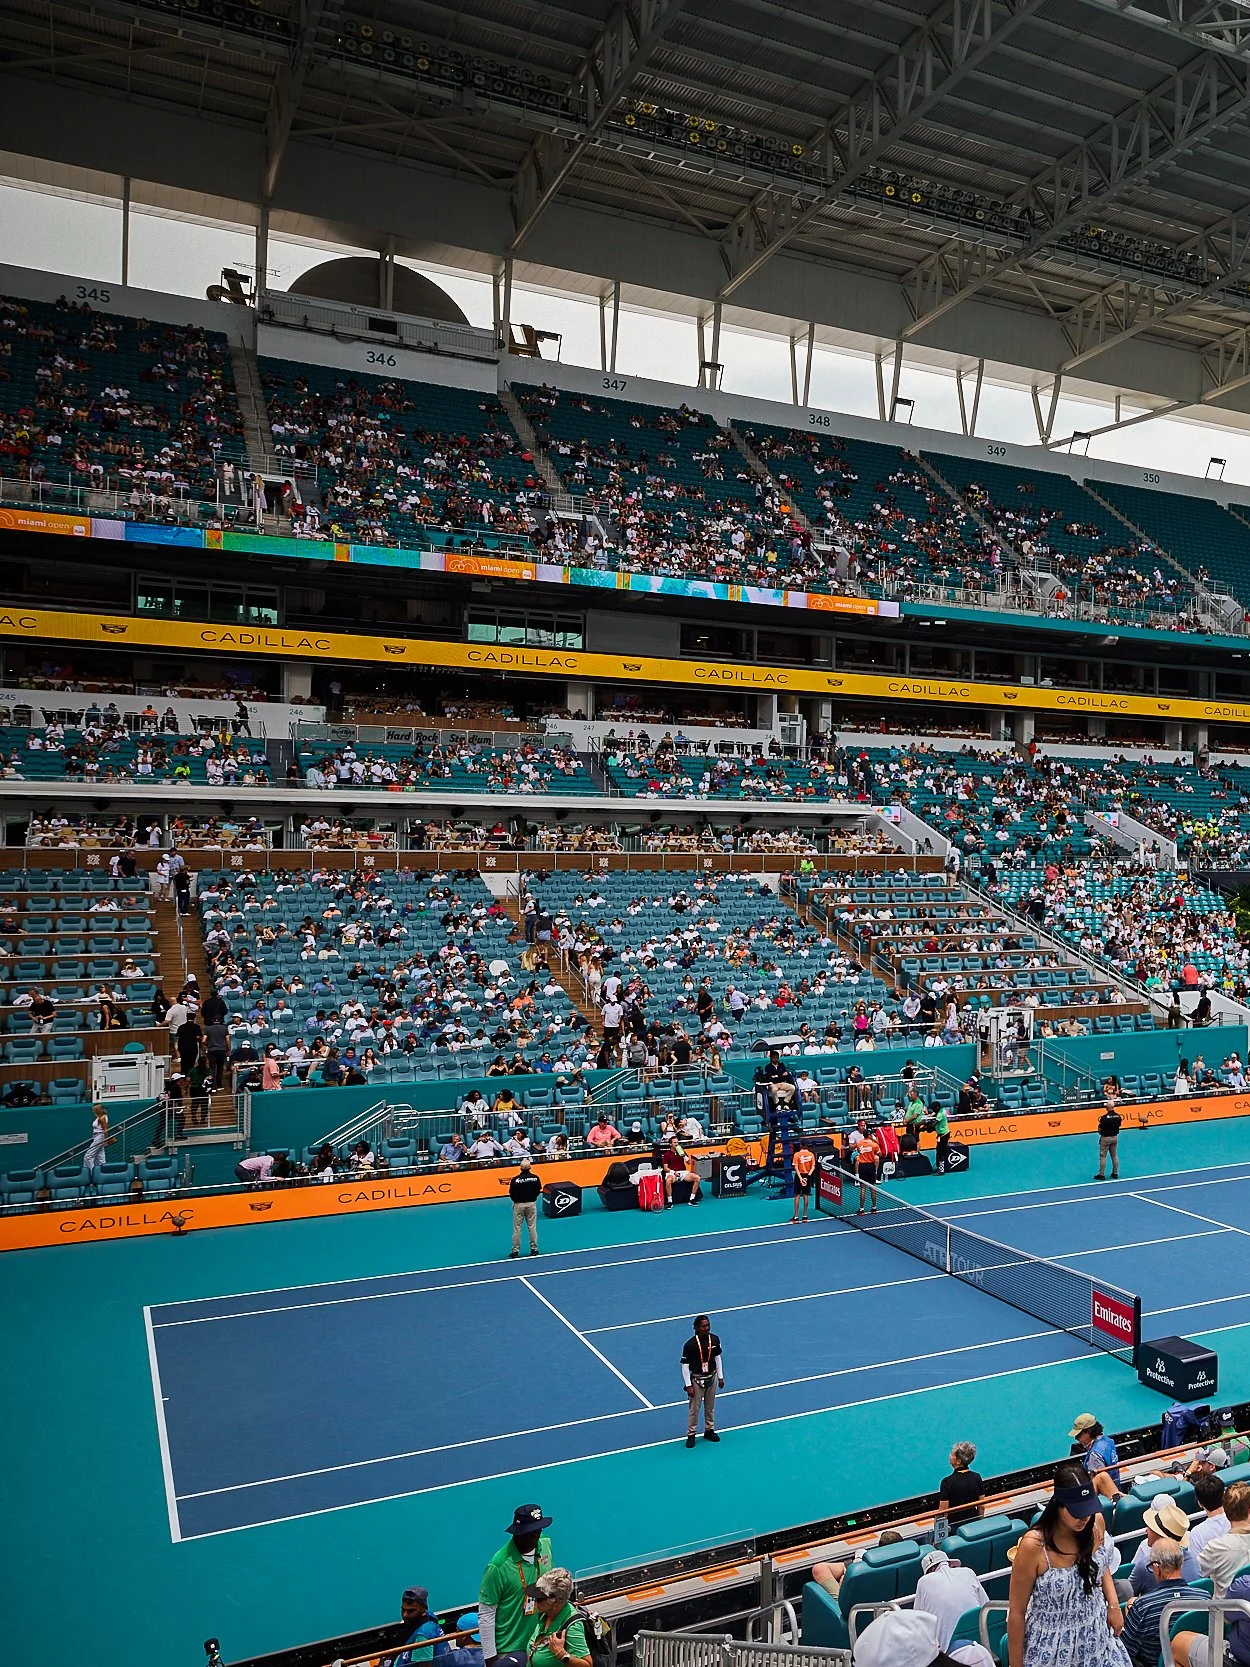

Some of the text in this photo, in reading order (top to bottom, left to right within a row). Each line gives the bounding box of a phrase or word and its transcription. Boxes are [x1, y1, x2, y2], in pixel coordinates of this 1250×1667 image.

[76, 285, 111, 303] 345
[366, 350, 397, 367] 346
[602, 377, 627, 392] 347
[808, 413, 831, 427] 348
[987, 444, 1006, 457] 349
[1142, 473, 1160, 484] 350
[17, 517, 70, 530] miami open
[480, 564, 521, 574] miami open
[852, 603, 867, 611] open
[200, 630, 331, 651] CADILLAC
[467, 650, 578, 669] CADILLAC
[694, 668, 788, 684] CADILLAC
[888, 682, 970, 697] CADILLAC
[1056, 695, 1129, 709] CADILLAC
[288, 708, 304, 716] 246
[386, 730, 411, 742] Hard
[415, 731, 439, 743] Rock
[338, 1182, 452, 1204] CADILLAC
[820, 1178, 841, 1198] Emirates
[924, 1240, 984, 1286] ATP TOUR
[1094, 1300, 1132, 1333] Emirates
[1146, 1367, 1174, 1388] Protective
[1188, 1378, 1215, 1391] Protective
